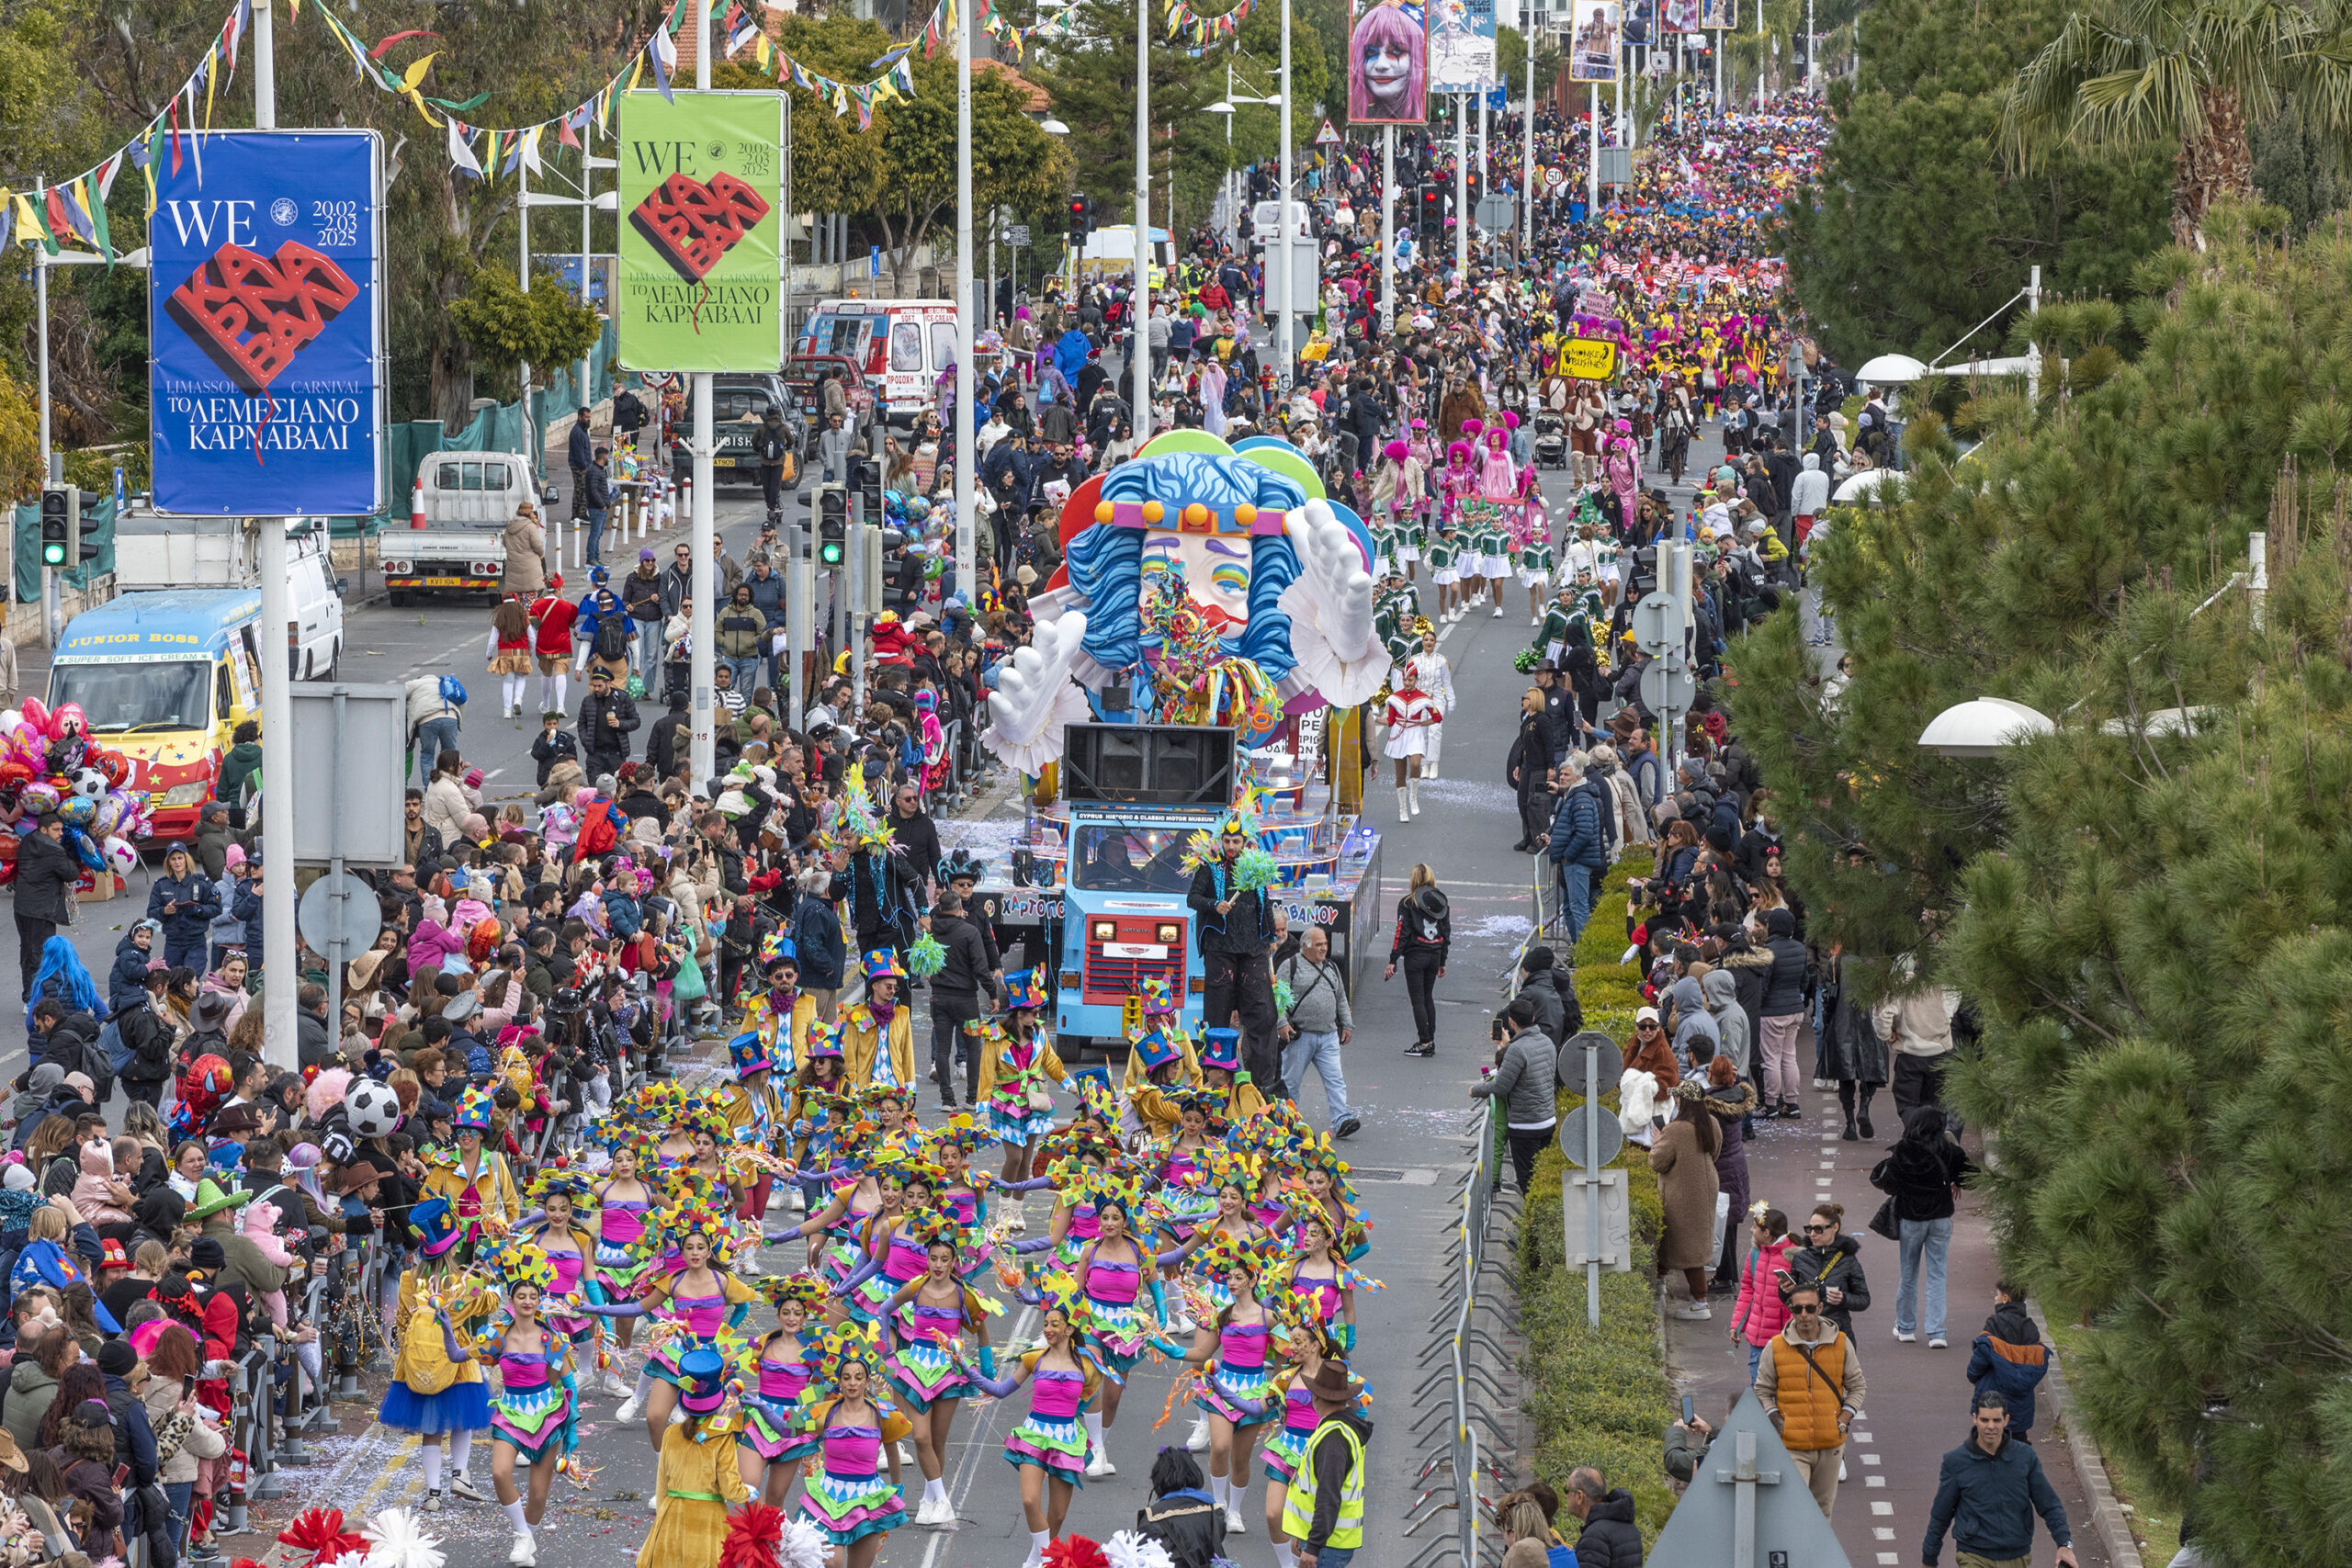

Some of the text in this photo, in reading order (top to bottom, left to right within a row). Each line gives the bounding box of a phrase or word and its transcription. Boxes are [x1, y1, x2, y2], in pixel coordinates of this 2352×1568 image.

[738, 142, 770, 154] 20.02
[632, 141, 696, 175] WE
[741, 164, 770, 176] 2025
[1548, 170, 1561, 182] 50
[312, 200, 356, 217] 20.02
[166, 199, 256, 247] WE
[317, 231, 356, 246] 2025
[629, 272, 772, 283] LIMASSOL CARNIVAL
[647, 286, 770, 304] ΛΕΜΕΣΙΑΝΟ
[646, 305, 761, 323] ΚΑΡΝΑΒΑΛΙ
[166, 380, 363, 394] LIMASSOL CARNIVAL
[167, 397, 358, 423] ΤΟ ΛΕΜΕΣΙΑΝΟ
[189, 425, 348, 450] ΚΑΡΝΑΒΑΛΙ
[69, 633, 198, 648] JUNIOR BOSS
[696, 732, 707, 740] 15
[1265, 745, 1313, 754] ΟΔΗΩΝ
[1001, 894, 1066, 919] ΧΑΡΤΟΠΟ
